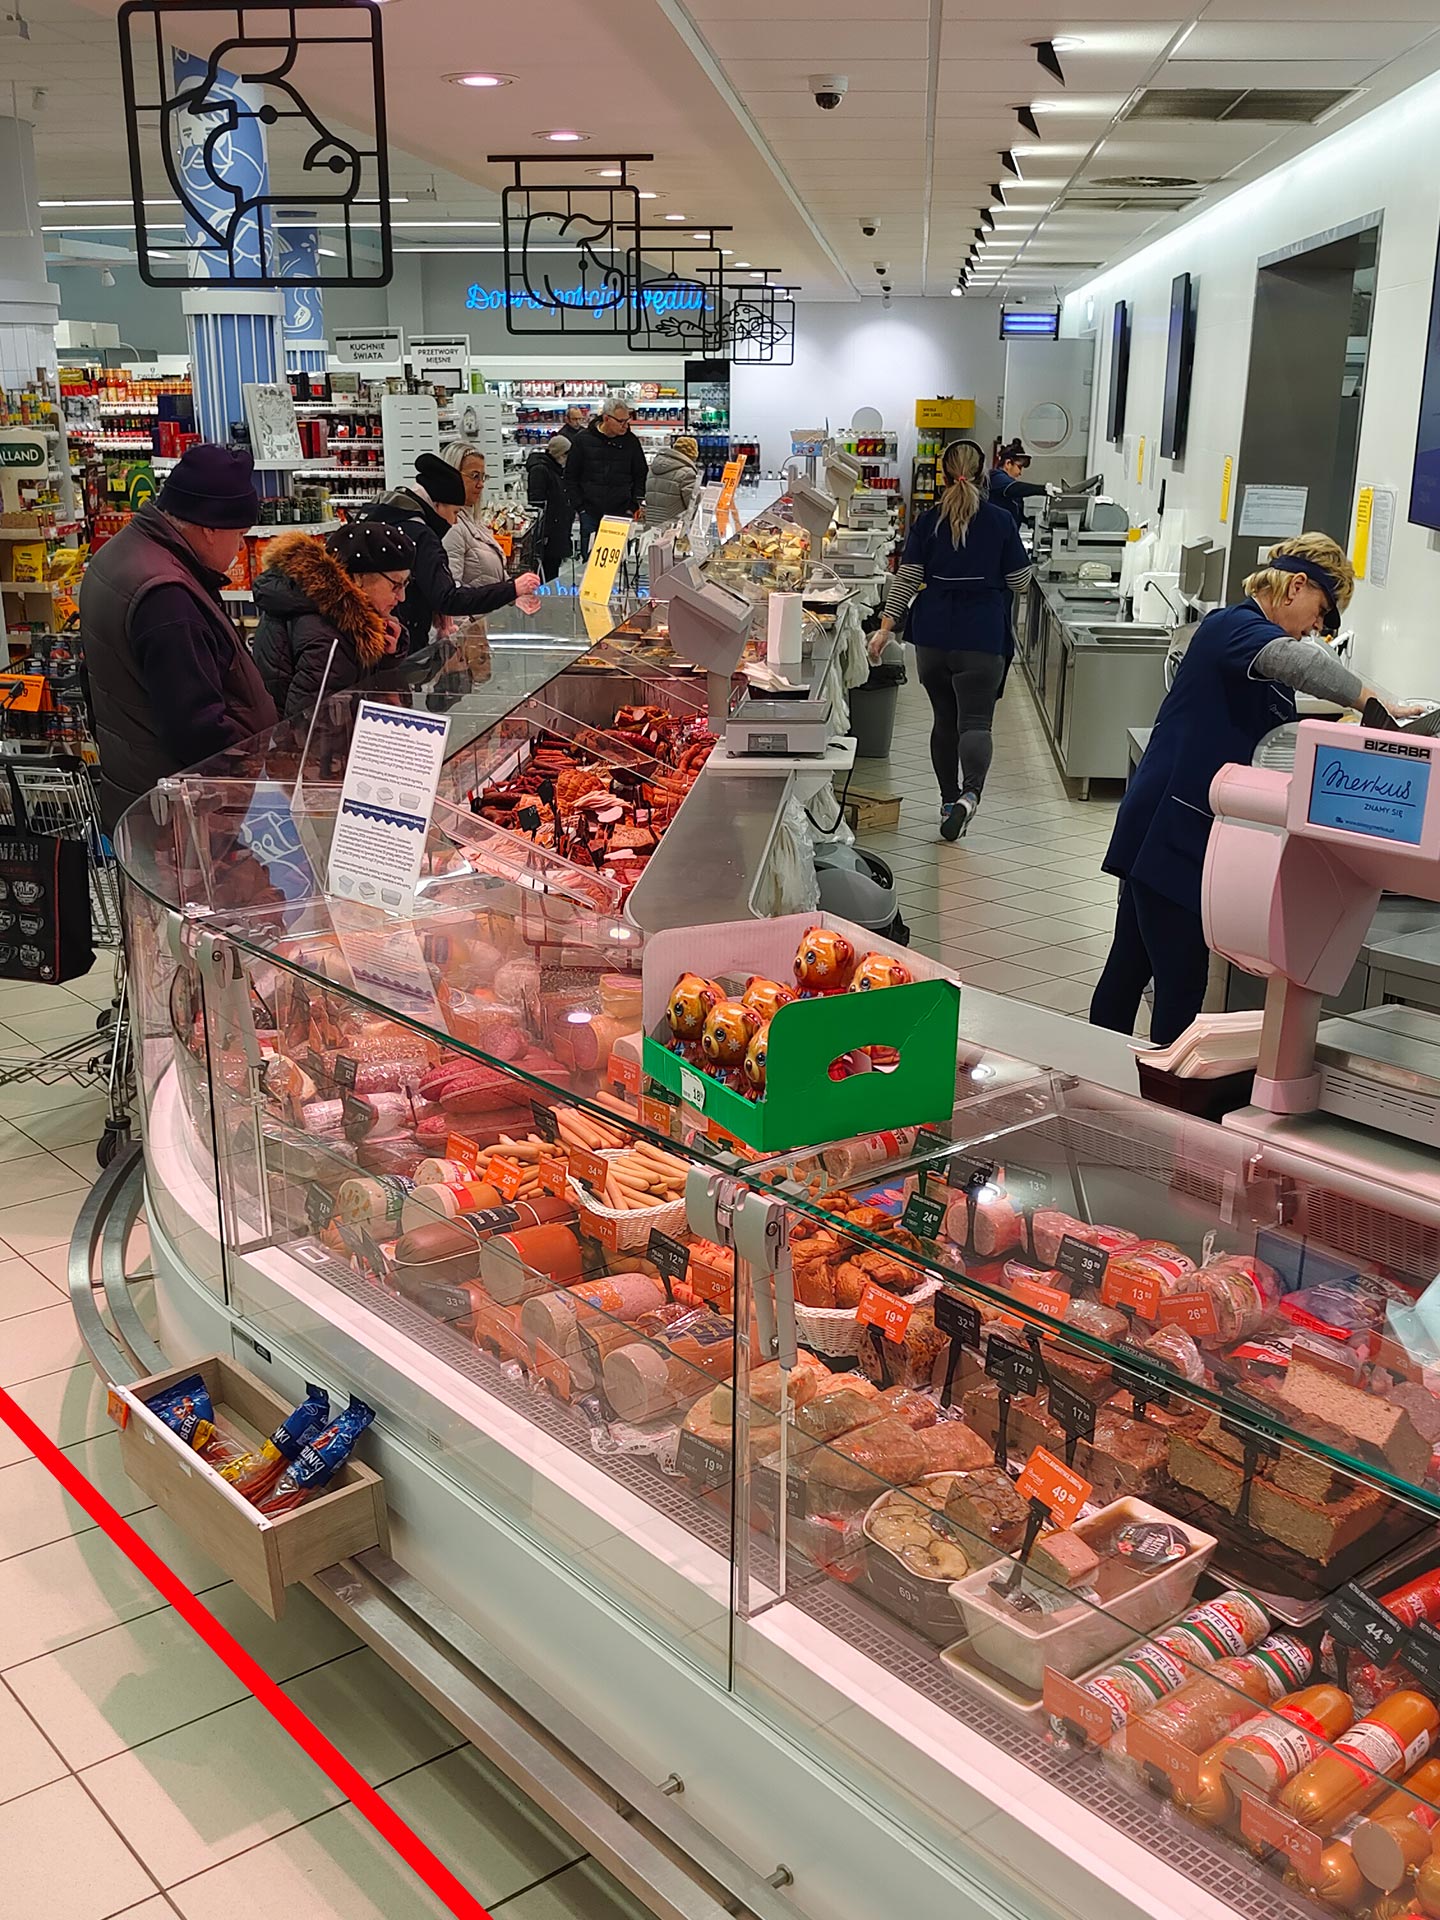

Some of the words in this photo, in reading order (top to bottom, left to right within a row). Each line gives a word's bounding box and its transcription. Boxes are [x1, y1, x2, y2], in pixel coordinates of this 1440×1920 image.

[349, 343, 385, 351] KUCHNIE
[417, 348, 459, 356] PRZETWORY
[353, 352, 383, 360] ŚWIATA
[425, 357, 451, 365] MIĘSNE
[1364, 740, 1431, 759] BIZERBA
[1321, 760, 1412, 800] Merkus
[1364, 803, 1390, 815] ZNAMY
[1391, 808, 1404, 819] SIĘ
[1210, 1602, 1242, 1631] Duda
